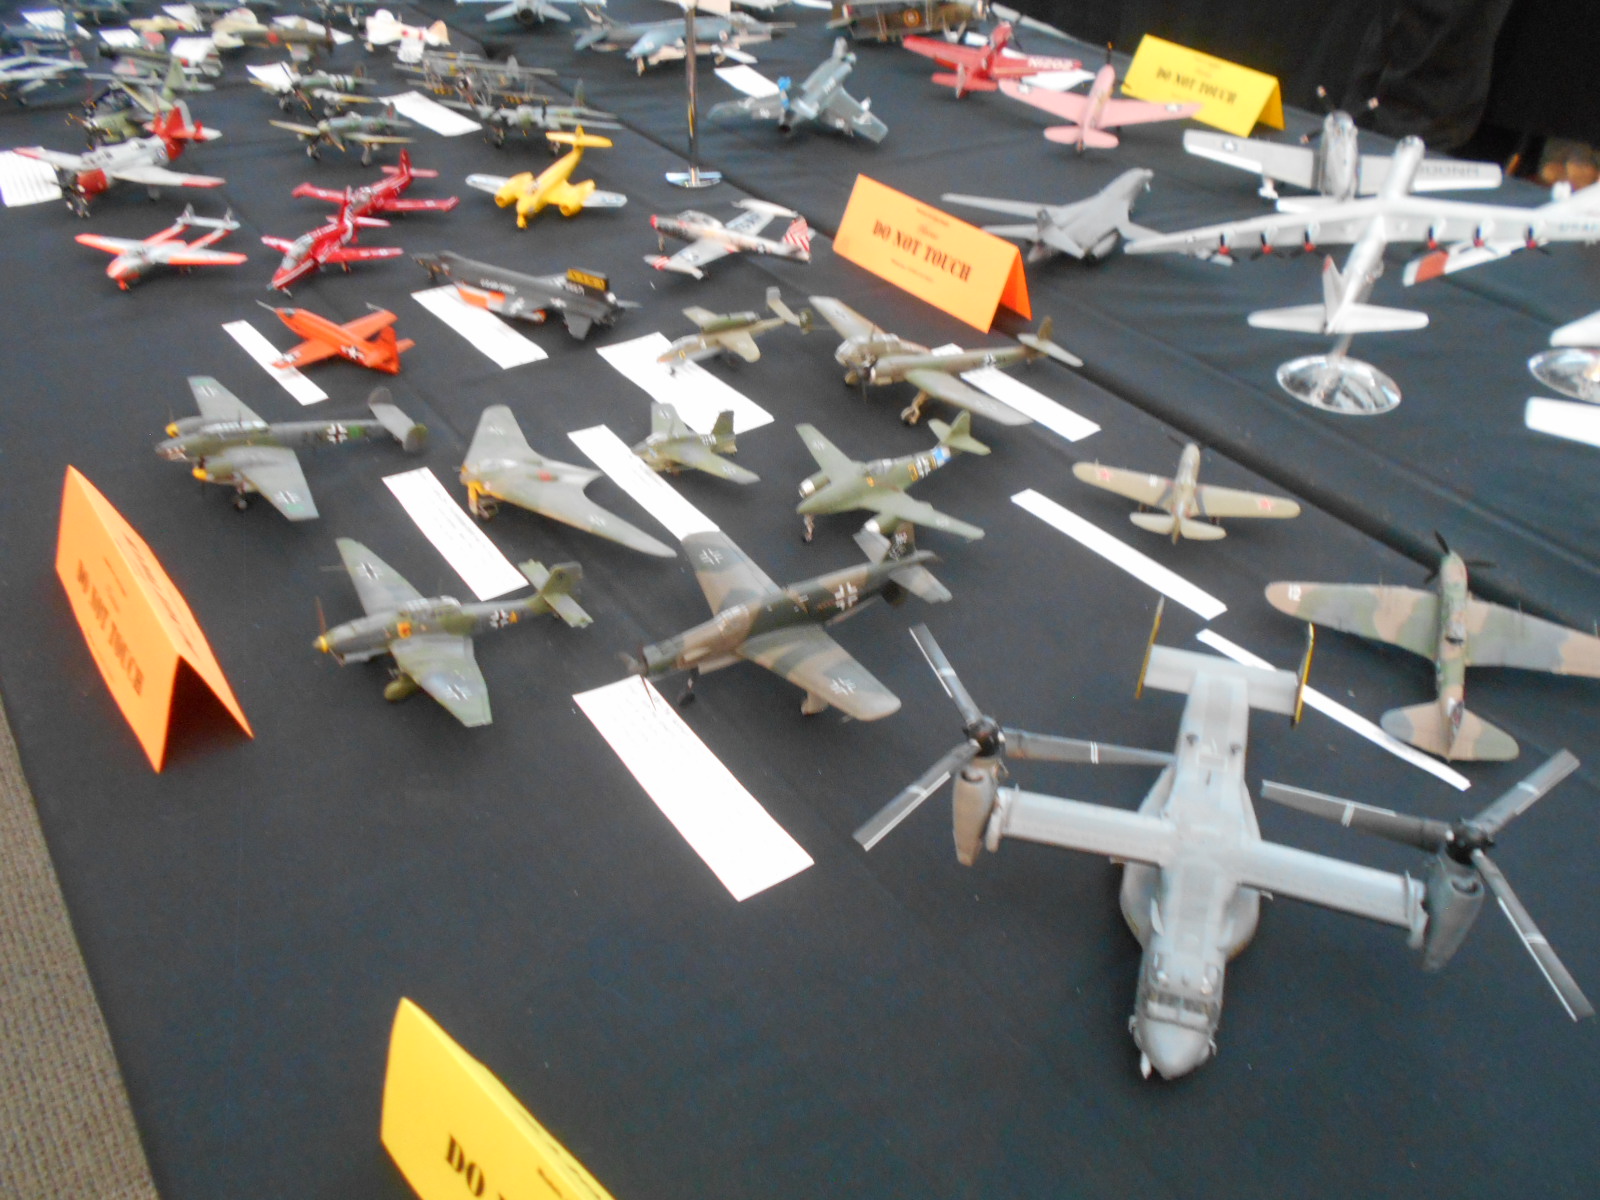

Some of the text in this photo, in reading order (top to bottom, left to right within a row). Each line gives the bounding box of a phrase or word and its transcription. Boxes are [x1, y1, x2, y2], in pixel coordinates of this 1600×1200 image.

[1156, 66, 1172, 81] DO
[1176, 73, 1196, 91] NOT
[1199, 81, 1237, 105] TOUCH
[872, 219, 892, 241] DO
[893, 230, 923, 256] NOT
[924, 245, 973, 283] TOUCH
[88, 583, 109, 630] NOT
[108, 621, 144, 697] TOUCH
[446, 1133, 485, 1197] DO
